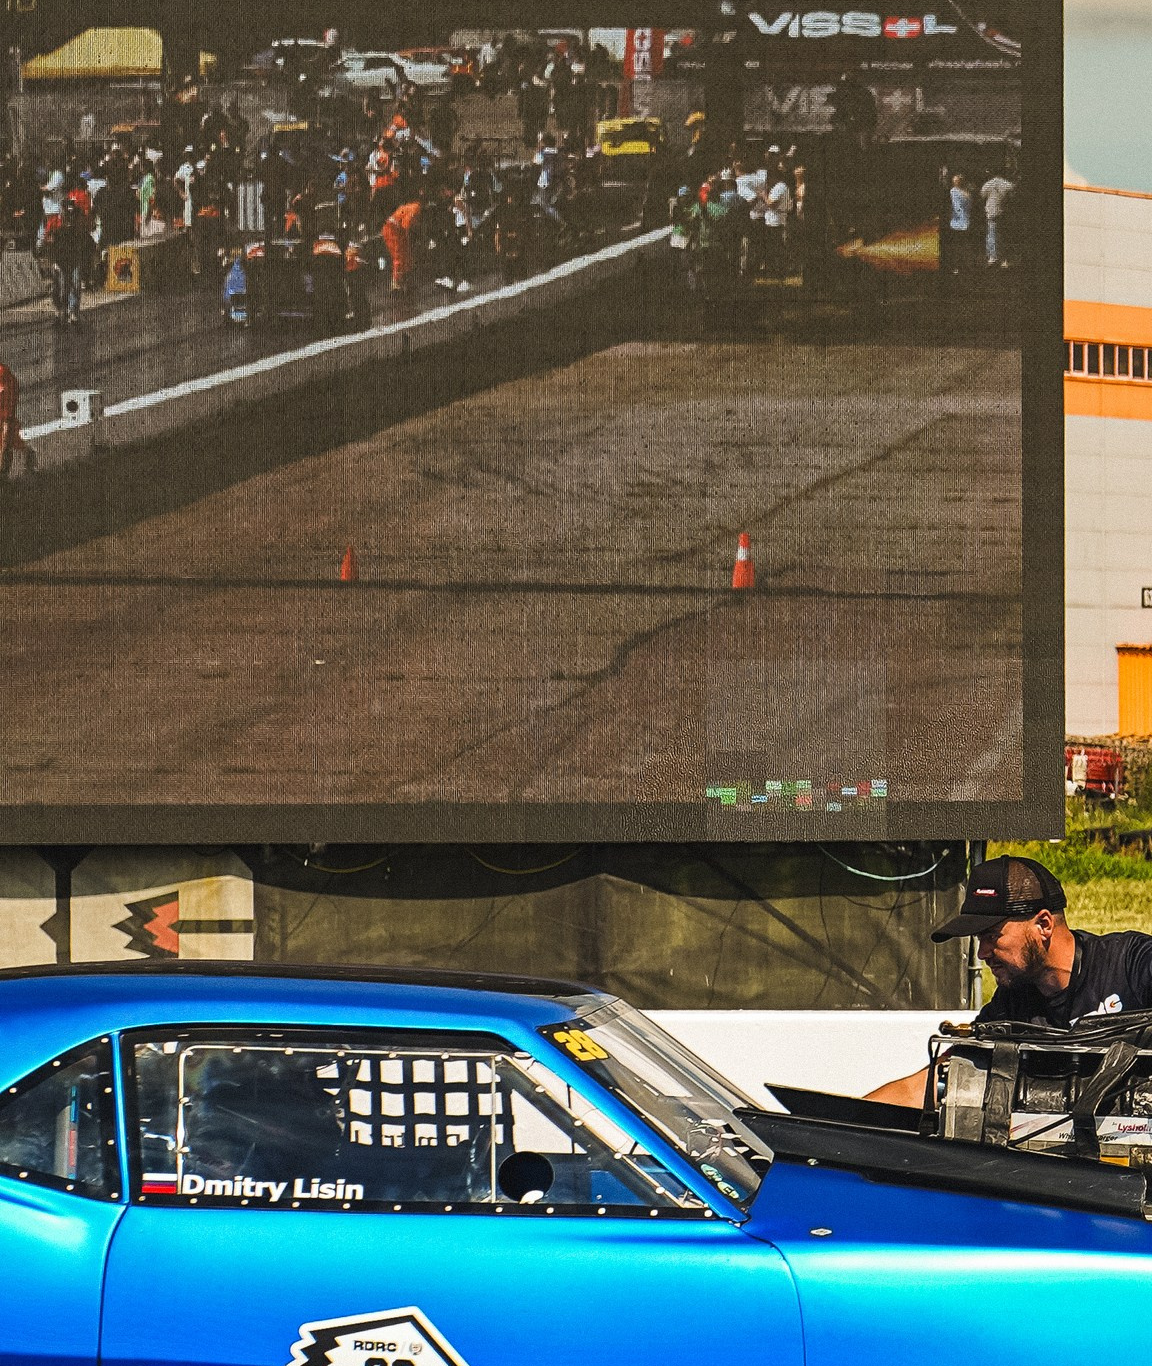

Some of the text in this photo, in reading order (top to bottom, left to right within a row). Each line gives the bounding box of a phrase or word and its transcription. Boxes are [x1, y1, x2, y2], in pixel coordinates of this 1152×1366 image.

[553, 1029, 610, 1062] 28
[181, 1174, 365, 1203] Dmitry Lisin
[353, 1339, 398, 1353] RDRC
